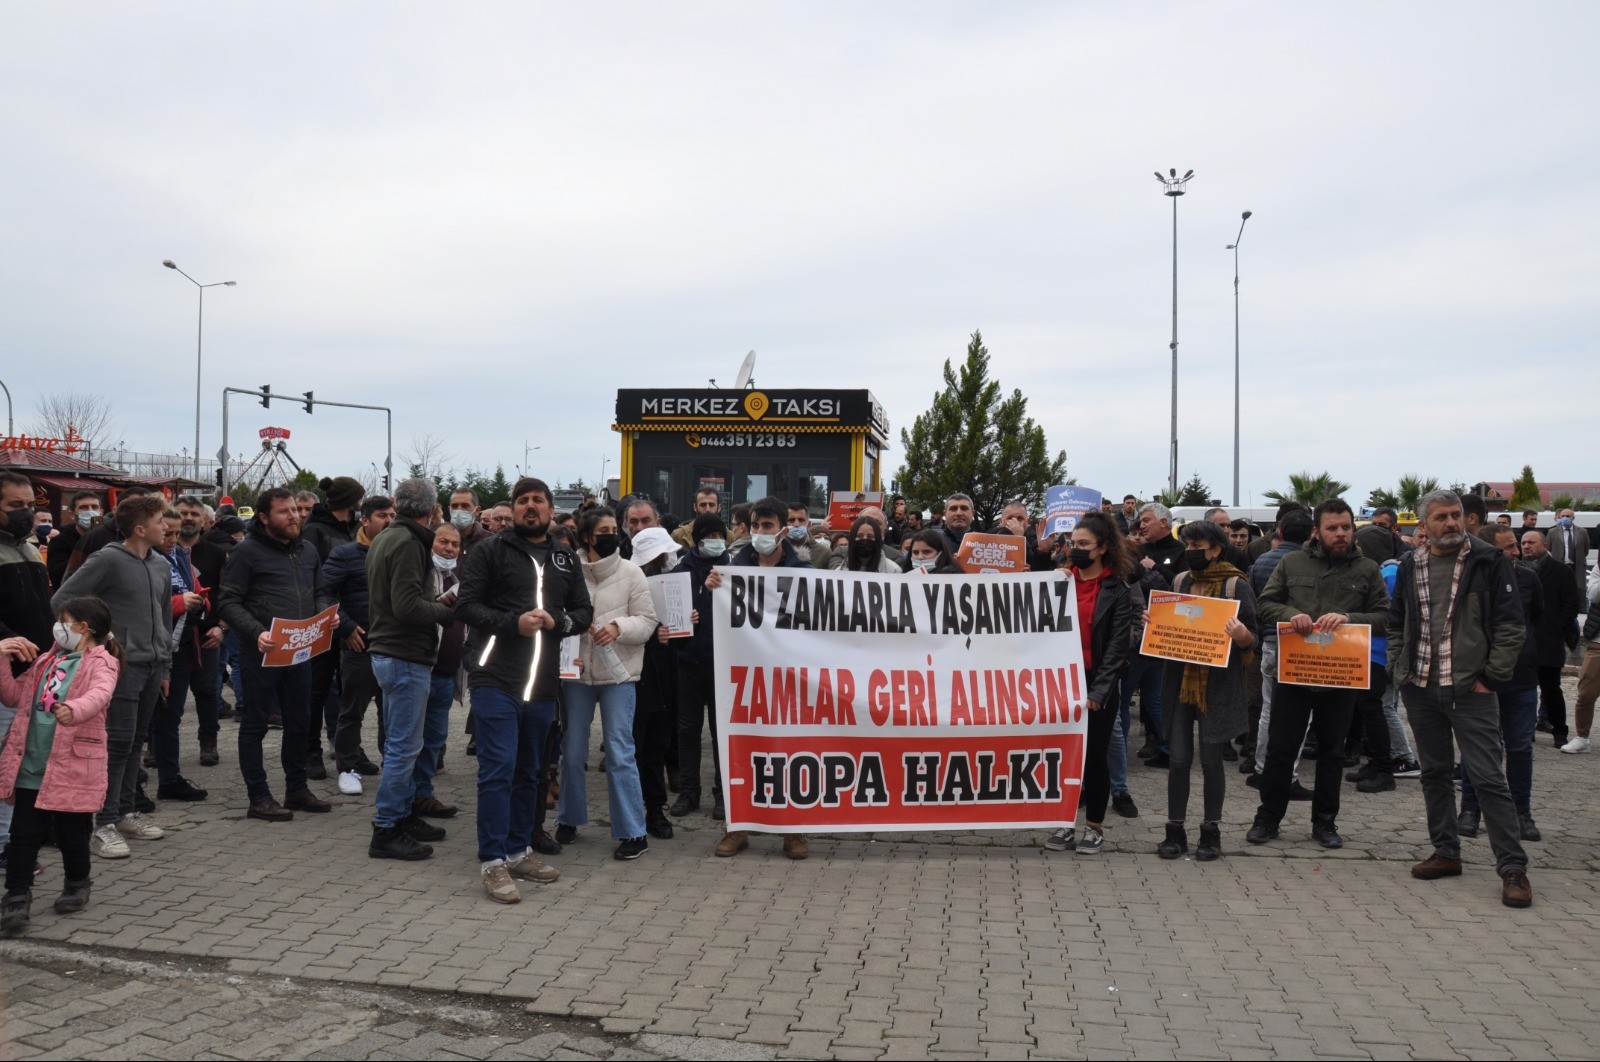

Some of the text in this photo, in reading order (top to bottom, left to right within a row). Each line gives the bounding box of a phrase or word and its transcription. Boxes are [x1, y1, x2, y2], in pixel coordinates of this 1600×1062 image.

[642, 398, 739, 414] MERKEZ
[0, 433, 59, 452] ahve
[972, 548, 1006, 560] GERİ
[731, 574, 765, 630] BU
[776, 576, 916, 634] ZAMLARLA
[922, 581, 1073, 650] YAŞANMAZ
[289, 627, 320, 643] GERİ
[730, 654, 1082, 726] ZAMLAR GERİ ALINSIN!
[752, 748, 1062, 809] HOPA HALKI
